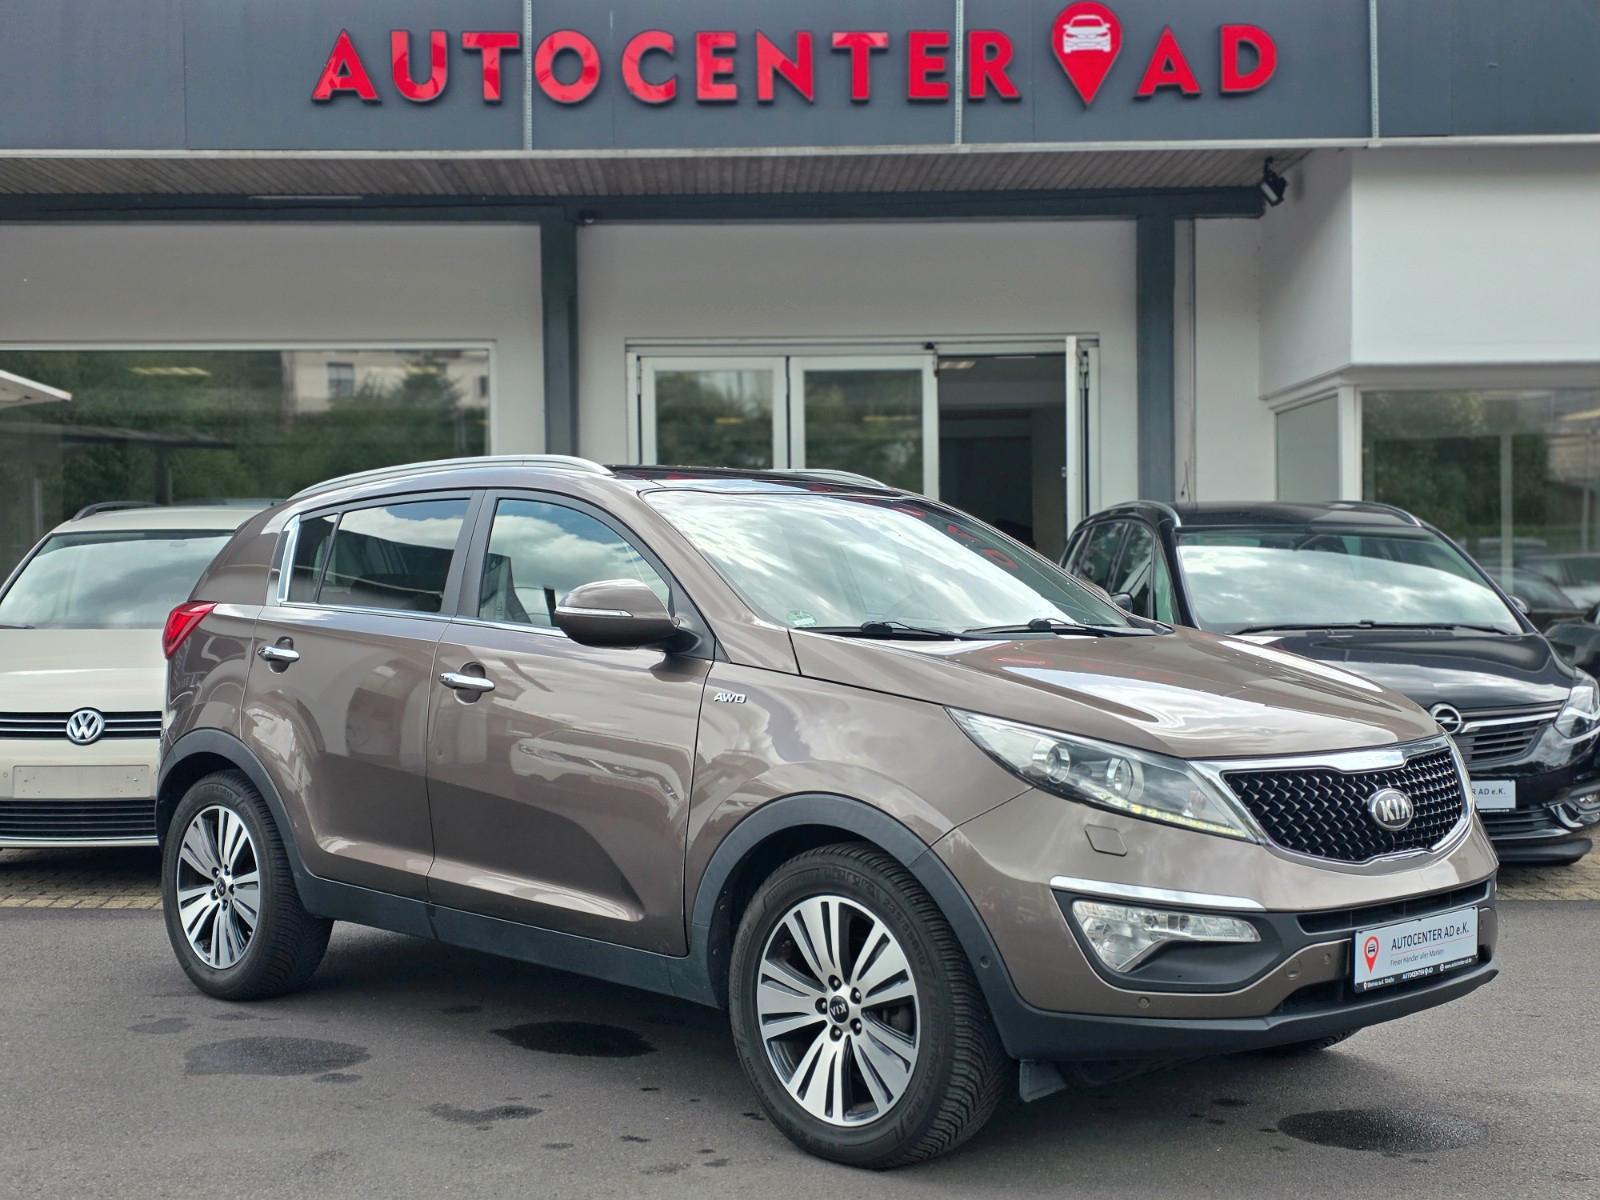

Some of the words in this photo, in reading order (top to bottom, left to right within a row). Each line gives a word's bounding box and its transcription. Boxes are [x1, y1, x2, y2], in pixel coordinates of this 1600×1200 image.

[311, 28, 1021, 104] AUTOCENTER
[1135, 25, 1278, 99] AD
[713, 692, 747, 704] AWD
[1379, 798, 1411, 822] KIA
[1391, 928, 1442, 951] AUTOCENTER
[1443, 925, 1455, 940] AD
